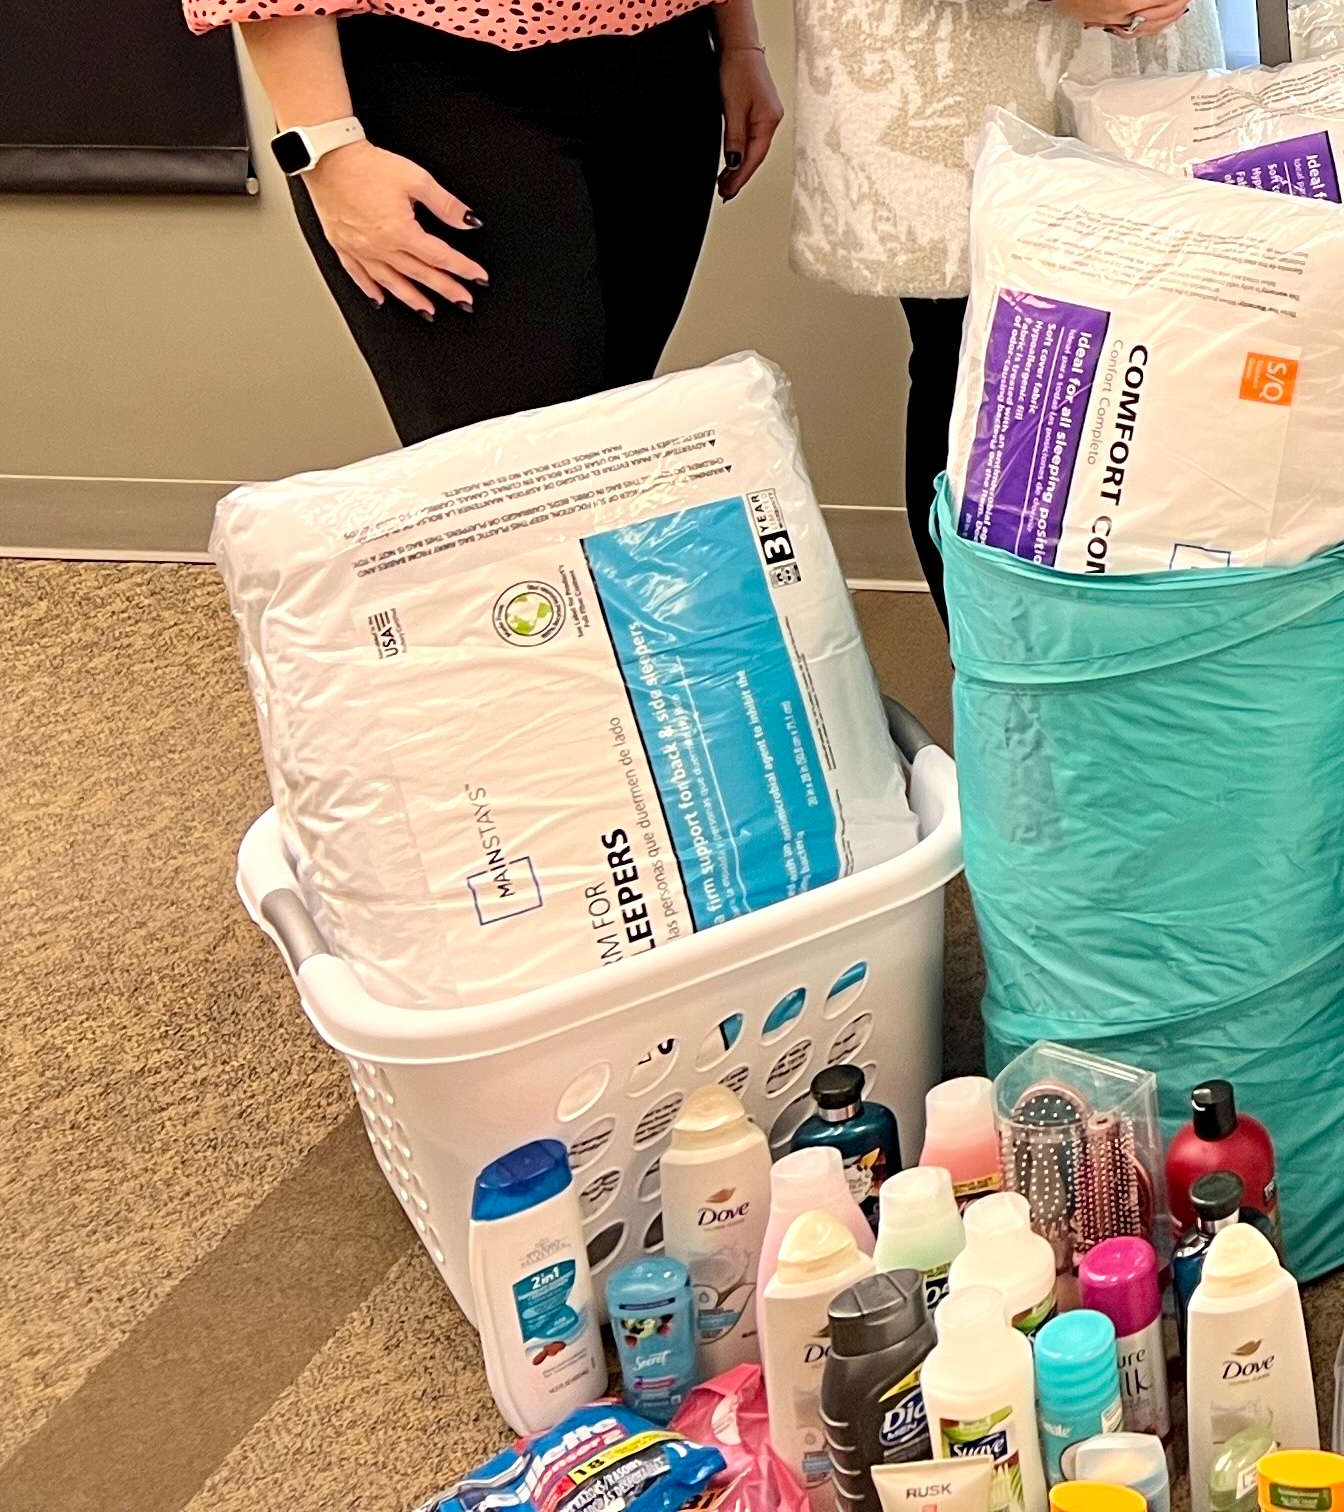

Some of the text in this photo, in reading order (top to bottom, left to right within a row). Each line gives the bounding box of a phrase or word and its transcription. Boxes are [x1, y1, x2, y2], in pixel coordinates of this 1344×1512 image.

[1306, 154, 1326, 189] Ideal
[996, 328, 1018, 405] odor-causing
[1001, 317, 1034, 431] Fabric treated with
[1017, 319, 1044, 403] Hypoallergenic
[1028, 322, 1058, 415] Soft cover fabric
[1042, 331, 1092, 504] Ideal for all sleeping
[1087, 339, 1124, 465] Confort Completo
[1100, 344, 1149, 507] COMFORT
[563, 464, 583, 475] ESTA
[602, 461, 629, 474] EVITAR
[378, 483, 622, 560] BAG BAG NOT
[407, 525, 510, 562] PLASTIC BAG FROM
[750, 494, 791, 561] 3 YEAR
[380, 625, 399, 658] USA
[628, 621, 723, 913] firm support for back side sleepers
[755, 740, 774, 771] agent
[468, 786, 516, 899] MAINSTAYS
[608, 716, 681, 941] las personas que duermen de lado
[585, 880, 616, 931] FOR
[601, 827, 657, 957] LEEPERS
[696, 1200, 751, 1227] Dove
[530, 1266, 560, 1290] 2in1
[632, 1349, 672, 1372] Secret
[1222, 1353, 1277, 1381] Dove
[887, 1421, 918, 1441] MEN
[952, 1436, 1005, 1458] Suave
[906, 1482, 952, 1500] RUSK
